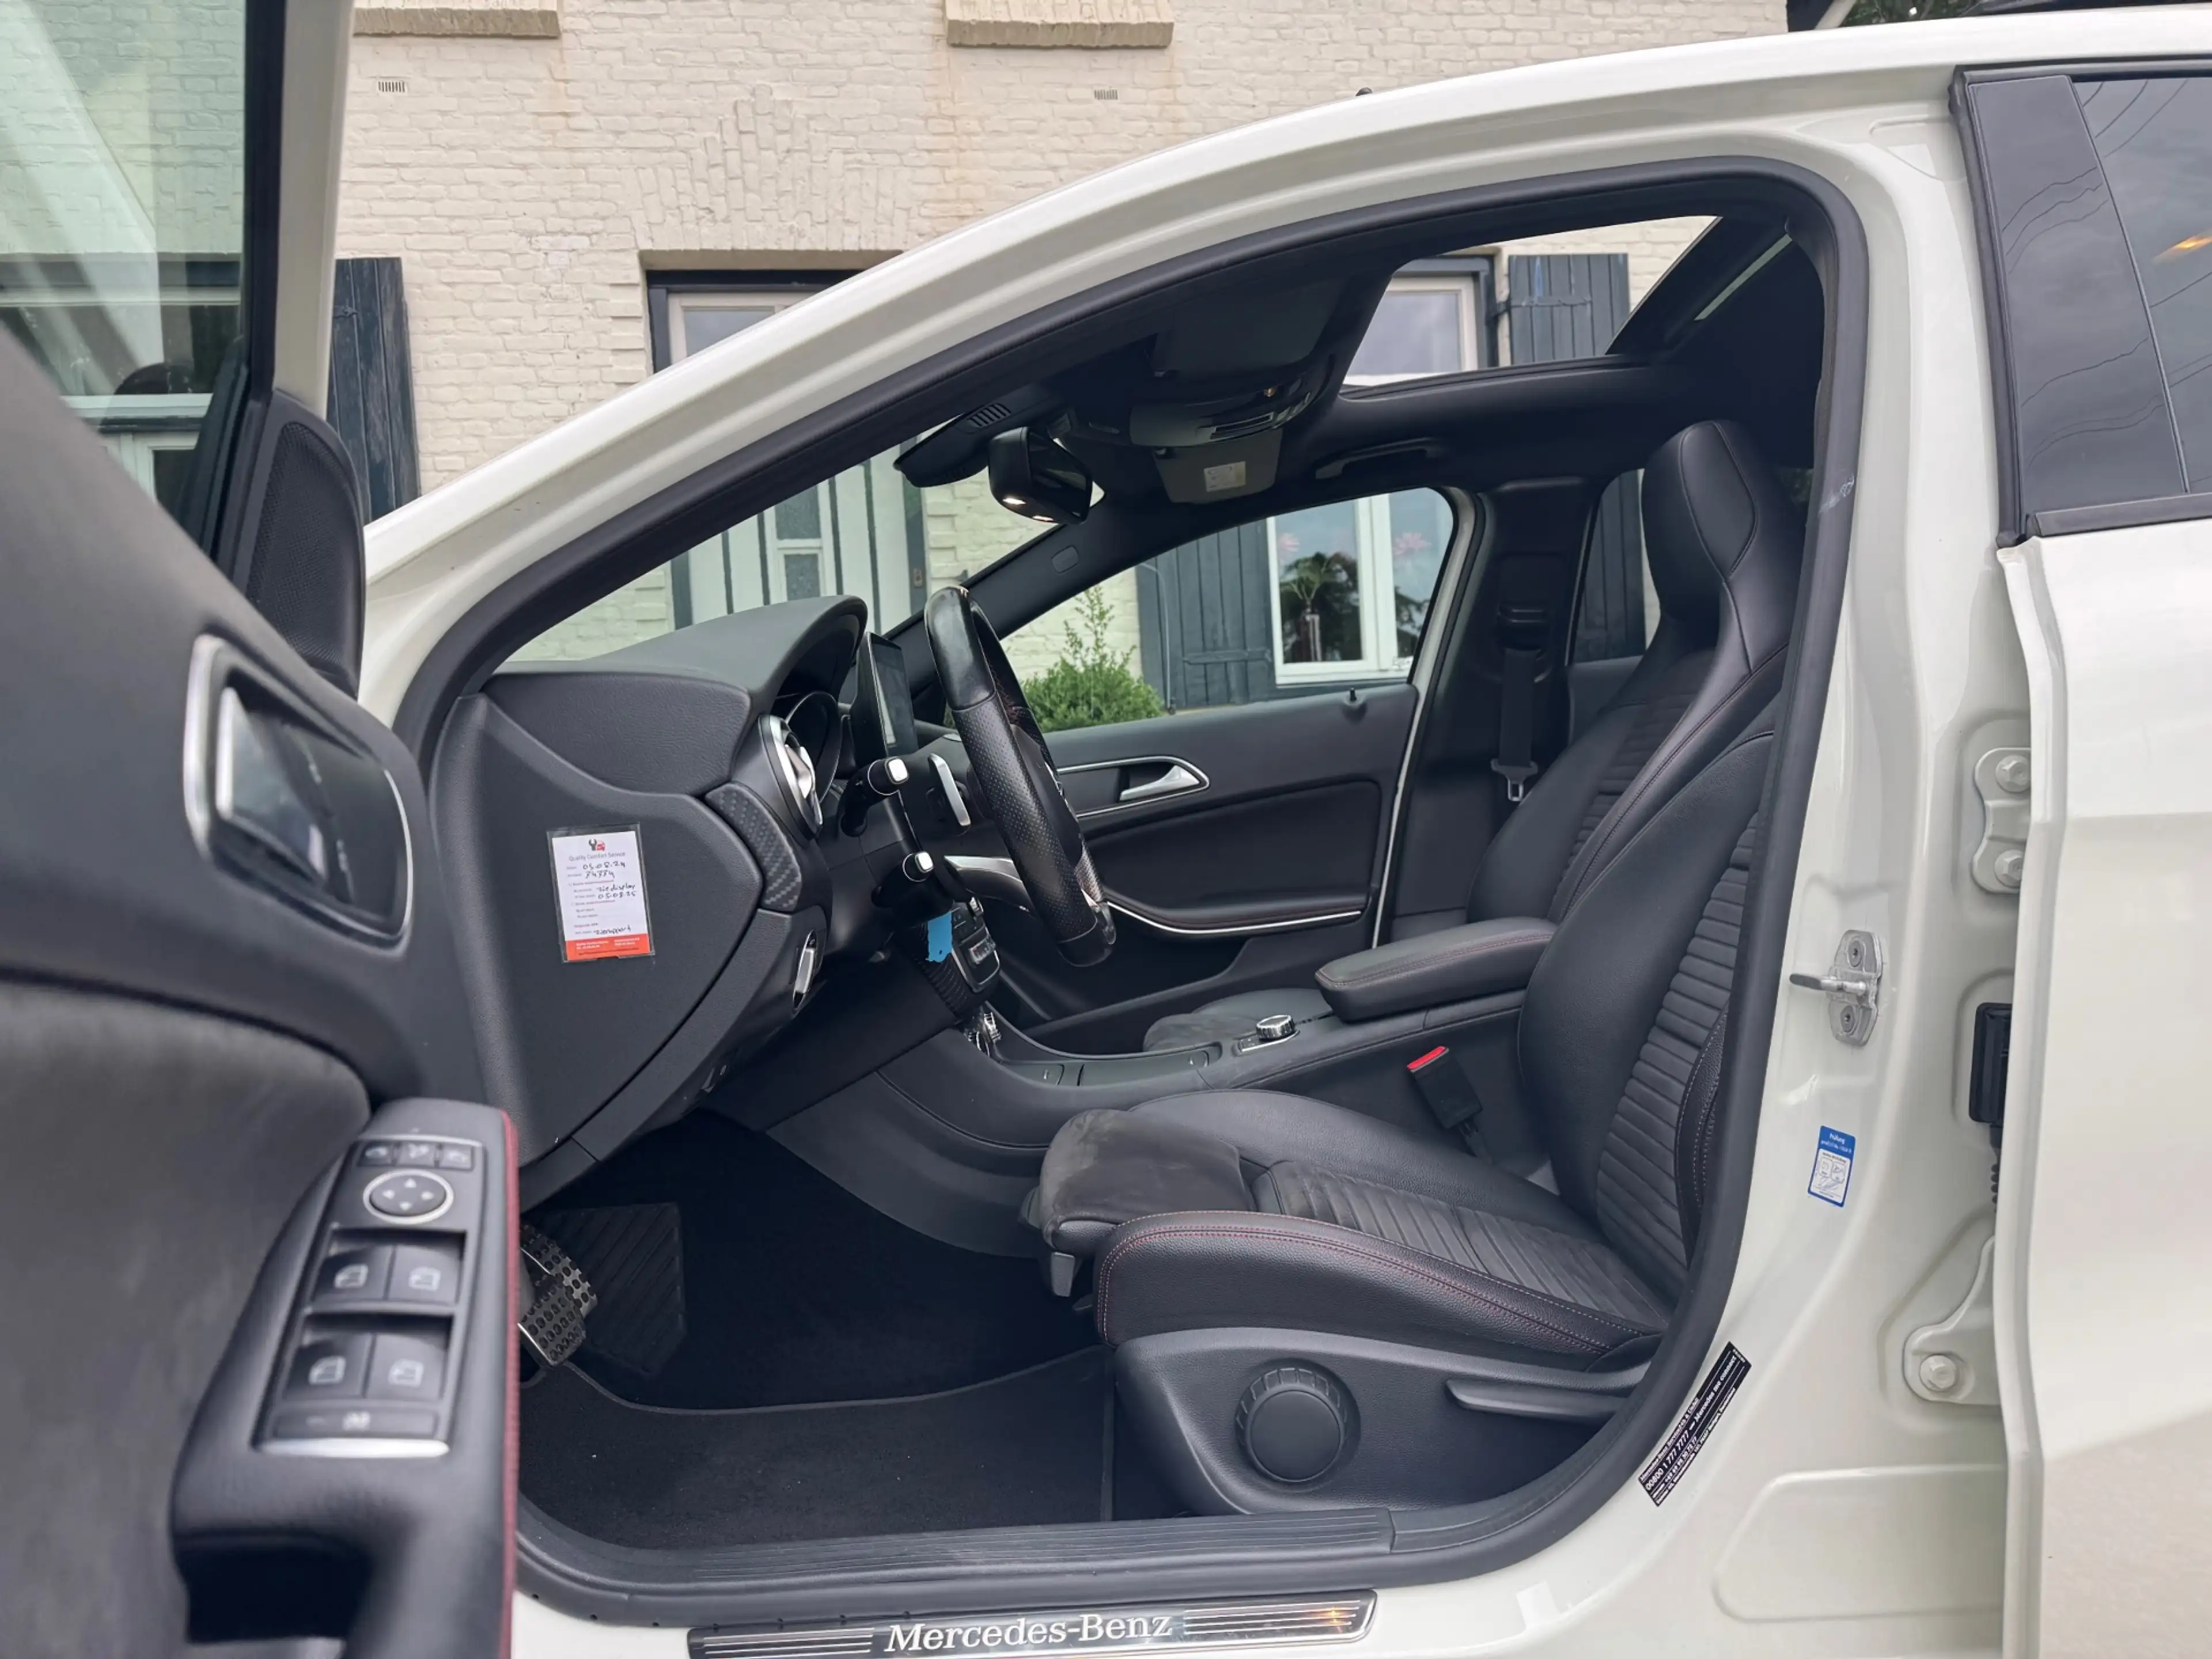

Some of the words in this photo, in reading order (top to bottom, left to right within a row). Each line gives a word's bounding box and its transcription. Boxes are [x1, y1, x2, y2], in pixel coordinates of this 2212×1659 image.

[1645, 1467, 1664, 1491] 00800
[1666, 1448, 1677, 1464] 777
[1677, 1429, 1690, 1450] 7777
[1695, 1392, 1714, 1422] Mercedes
[1720, 1355, 1737, 1381] connect
[884, 1613, 1173, 1653] Mercedes-Benz
